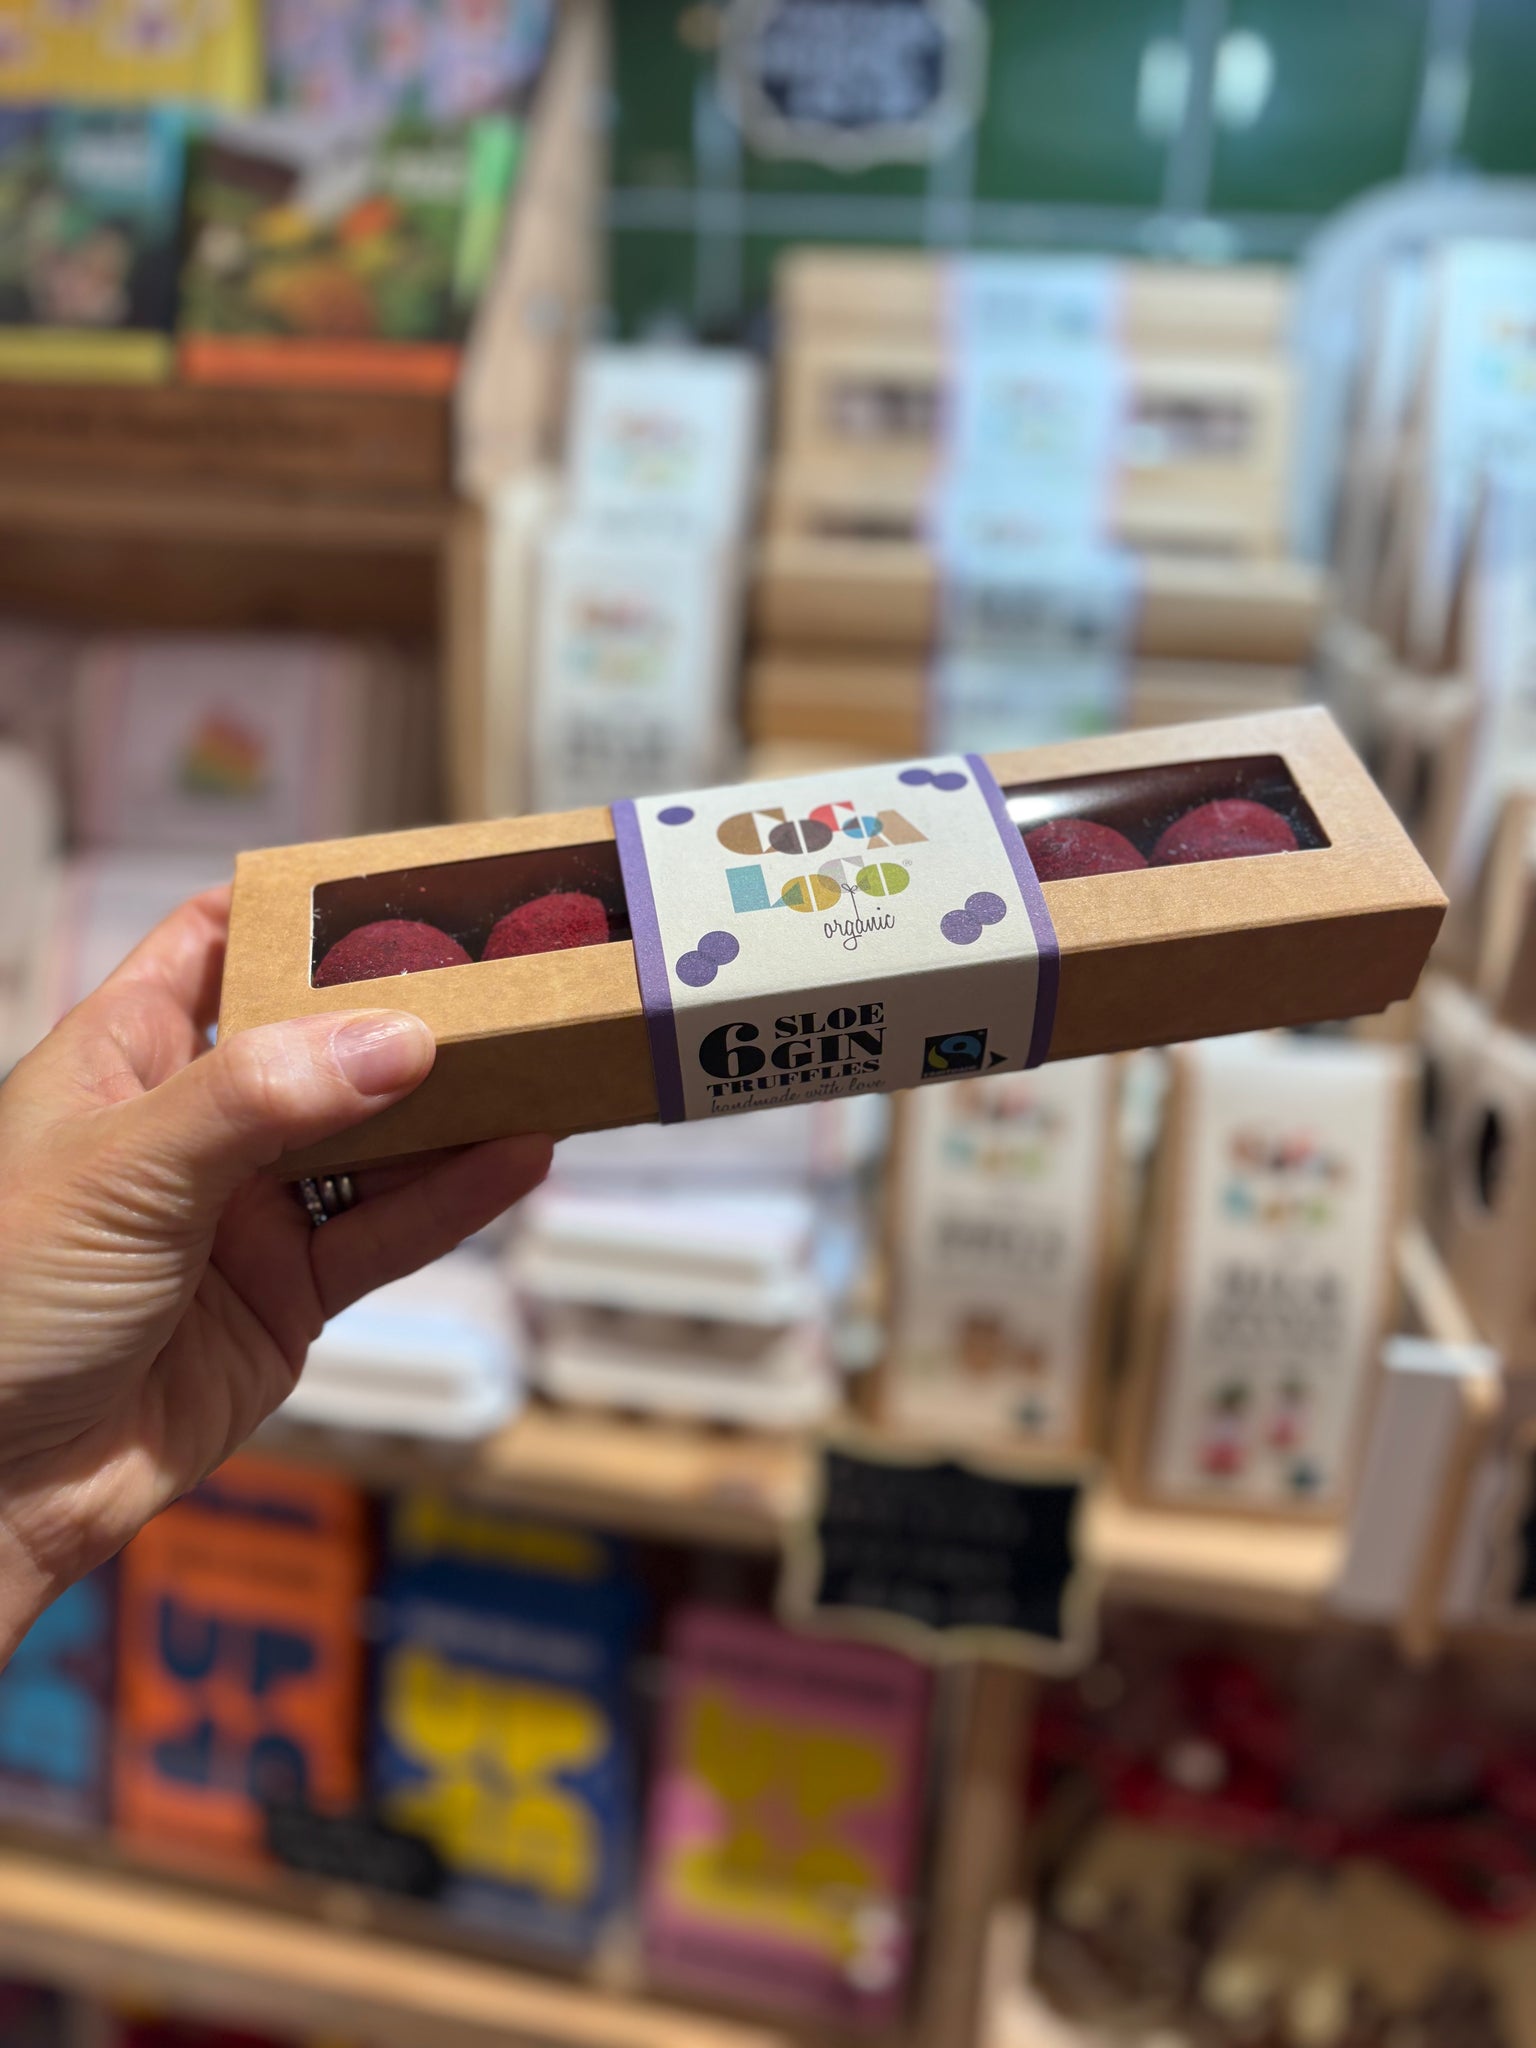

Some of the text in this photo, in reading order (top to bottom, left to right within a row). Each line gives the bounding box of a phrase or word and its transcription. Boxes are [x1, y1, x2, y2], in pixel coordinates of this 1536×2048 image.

[716, 800, 929, 855] COCOA
[725, 855, 910, 914] LOCO
[823, 906, 896, 951] organic
[698, 1002, 884, 1079] 6 SLOE
[771, 1027, 887, 1070] GIN
[706, 1058, 881, 1098] TRUFFLES
[711, 1076, 886, 1114] handmade with love
